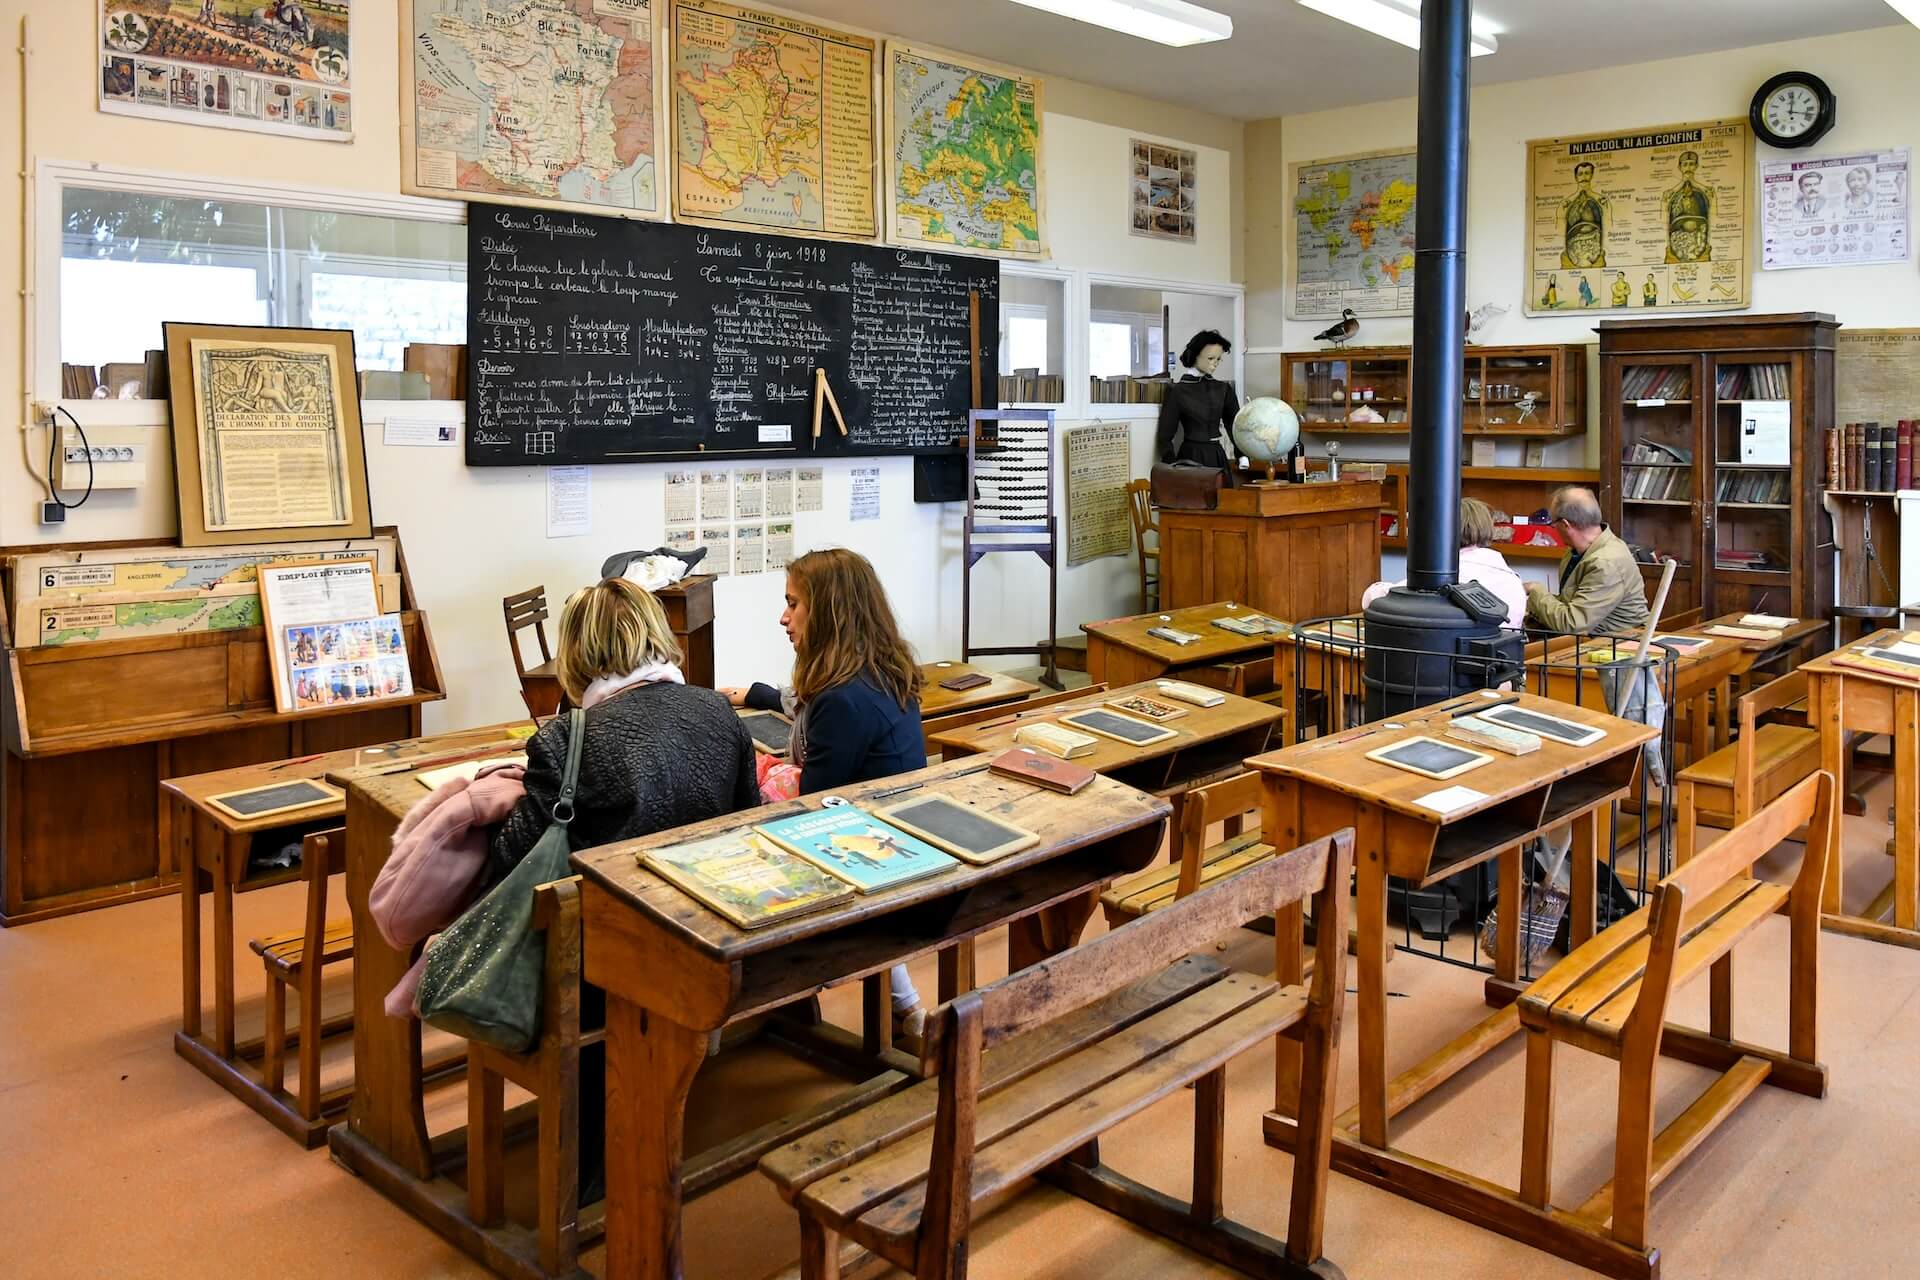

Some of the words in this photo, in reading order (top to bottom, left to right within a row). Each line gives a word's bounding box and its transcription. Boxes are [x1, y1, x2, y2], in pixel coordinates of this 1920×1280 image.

[486, 5, 531, 24] Prairies
[737, 10, 746, 18] LA
[749, 13, 775, 24] FRANCE
[418, 32, 438, 57] Vins
[686, 34, 726, 49] ANGLETERRE
[563, 66, 584, 78] Vins
[911, 80, 945, 113] Atlantique
[495, 112, 519, 125] Vins
[1573, 144, 1582, 153] NI
[1585, 141, 1620, 152] ALCOOL
[1623, 138, 1633, 148] NI
[1636, 136, 1652, 146] AIR
[543, 159, 564, 171] Vins
[686, 193, 733, 206] ESPAGNE
[928, 198, 942, 208] Mer
[495, 212, 530, 229] Cours
[533, 214, 597, 240] Préparatoire
[697, 233, 742, 257] Samedi
[755, 243, 762, 257] 8
[765, 245, 792, 270] juin
[796, 246, 826, 262] 1918
[506, 255, 551, 273] chasseur
[553, 259, 577, 275] tue
[578, 259, 590, 276] le
[639, 267, 674, 281] renard
[484, 273, 529, 295] trompa
[530, 275, 544, 289] le
[611, 281, 641, 303] loup
[642, 288, 679, 307] mange
[483, 287, 542, 312] l'agneau.
[493, 326, 501, 337] 6
[529, 326, 536, 336] 9
[570, 332, 582, 340] 12
[587, 332, 598, 340] 10
[614, 332, 627, 340] 16
[584, 371, 604, 386] bon
[607, 371, 623, 385] lait
[496, 401, 529, 418] faisant
[333, 552, 366, 560] FRANCE
[44, 575, 55, 587] 6
[277, 572, 318, 581] EMPLOI
[335, 567, 372, 576] TEMPS
[46, 617, 56, 629] 2
